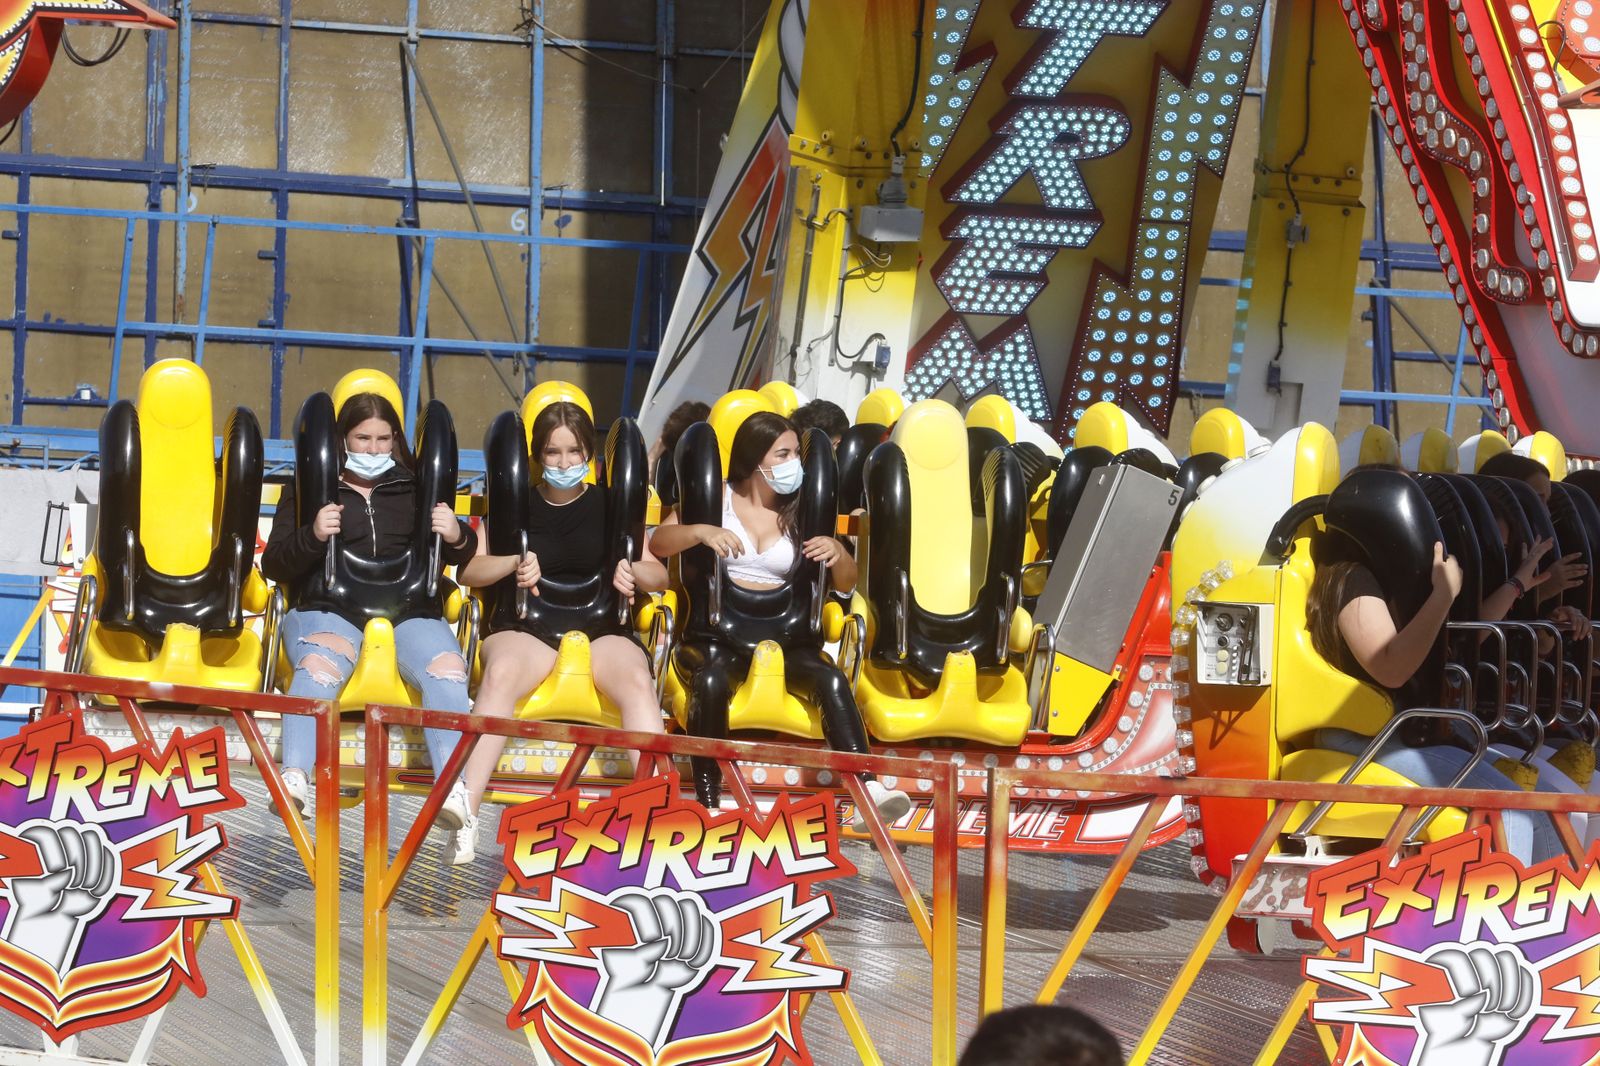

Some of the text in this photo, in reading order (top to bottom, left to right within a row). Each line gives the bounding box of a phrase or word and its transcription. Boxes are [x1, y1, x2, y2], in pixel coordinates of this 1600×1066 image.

[511, 207, 526, 231] 6
[1168, 489, 1180, 506] 5
[508, 783, 837, 894] EXTREME
